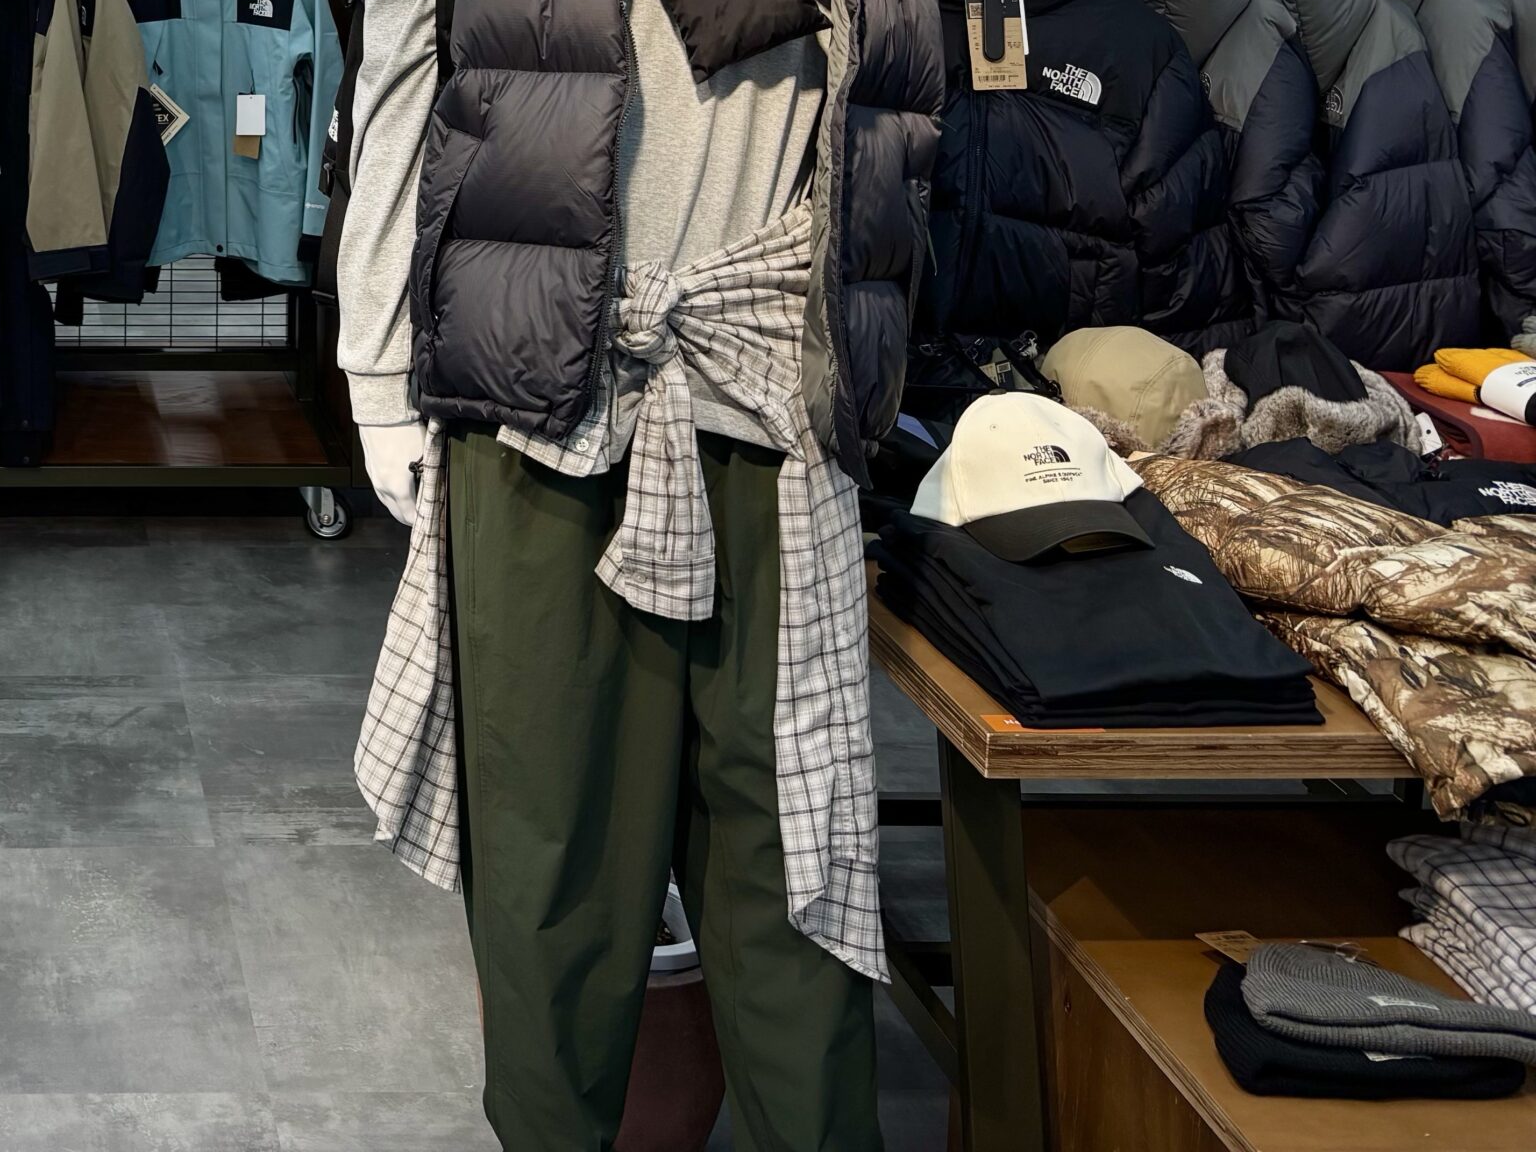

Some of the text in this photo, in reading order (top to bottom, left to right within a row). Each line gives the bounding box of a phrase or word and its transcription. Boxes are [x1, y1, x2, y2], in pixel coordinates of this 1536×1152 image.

[1042, 66, 1083, 88] NORTH
[1065, 63, 1089, 79] THE
[1050, 80, 1080, 98] FACE
[1033, 445, 1052, 453] THE
[1023, 450, 1054, 461] NORTH
[1034, 456, 1056, 466] FACE
[1492, 480, 1524, 492] THE
[1478, 487, 1531, 500] NORTH
[1500, 497, 1536, 507] FACE
